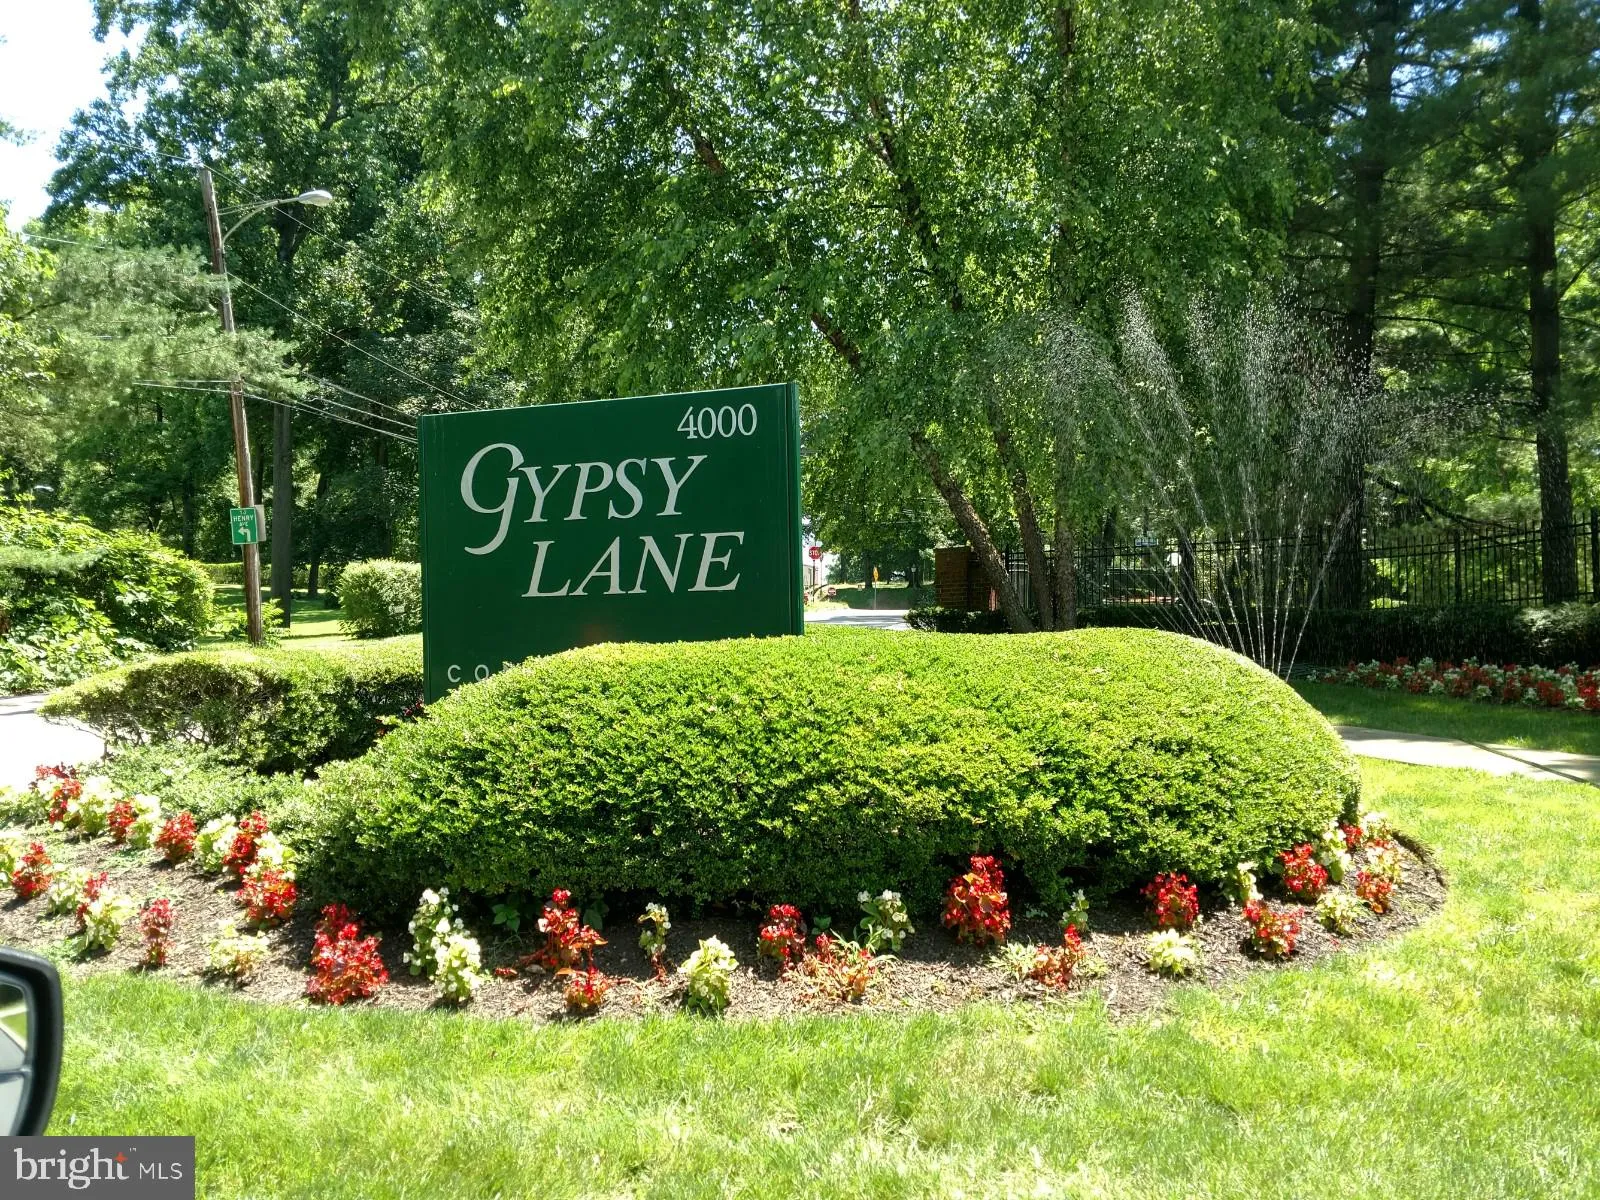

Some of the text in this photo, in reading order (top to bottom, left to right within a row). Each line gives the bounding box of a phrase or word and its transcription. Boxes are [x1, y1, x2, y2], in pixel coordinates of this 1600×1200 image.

[677, 403, 757, 439] 4000
[233, 514, 253, 522] HENRY
[460, 443, 707, 555] GYPSY
[521, 531, 745, 597] LANE
